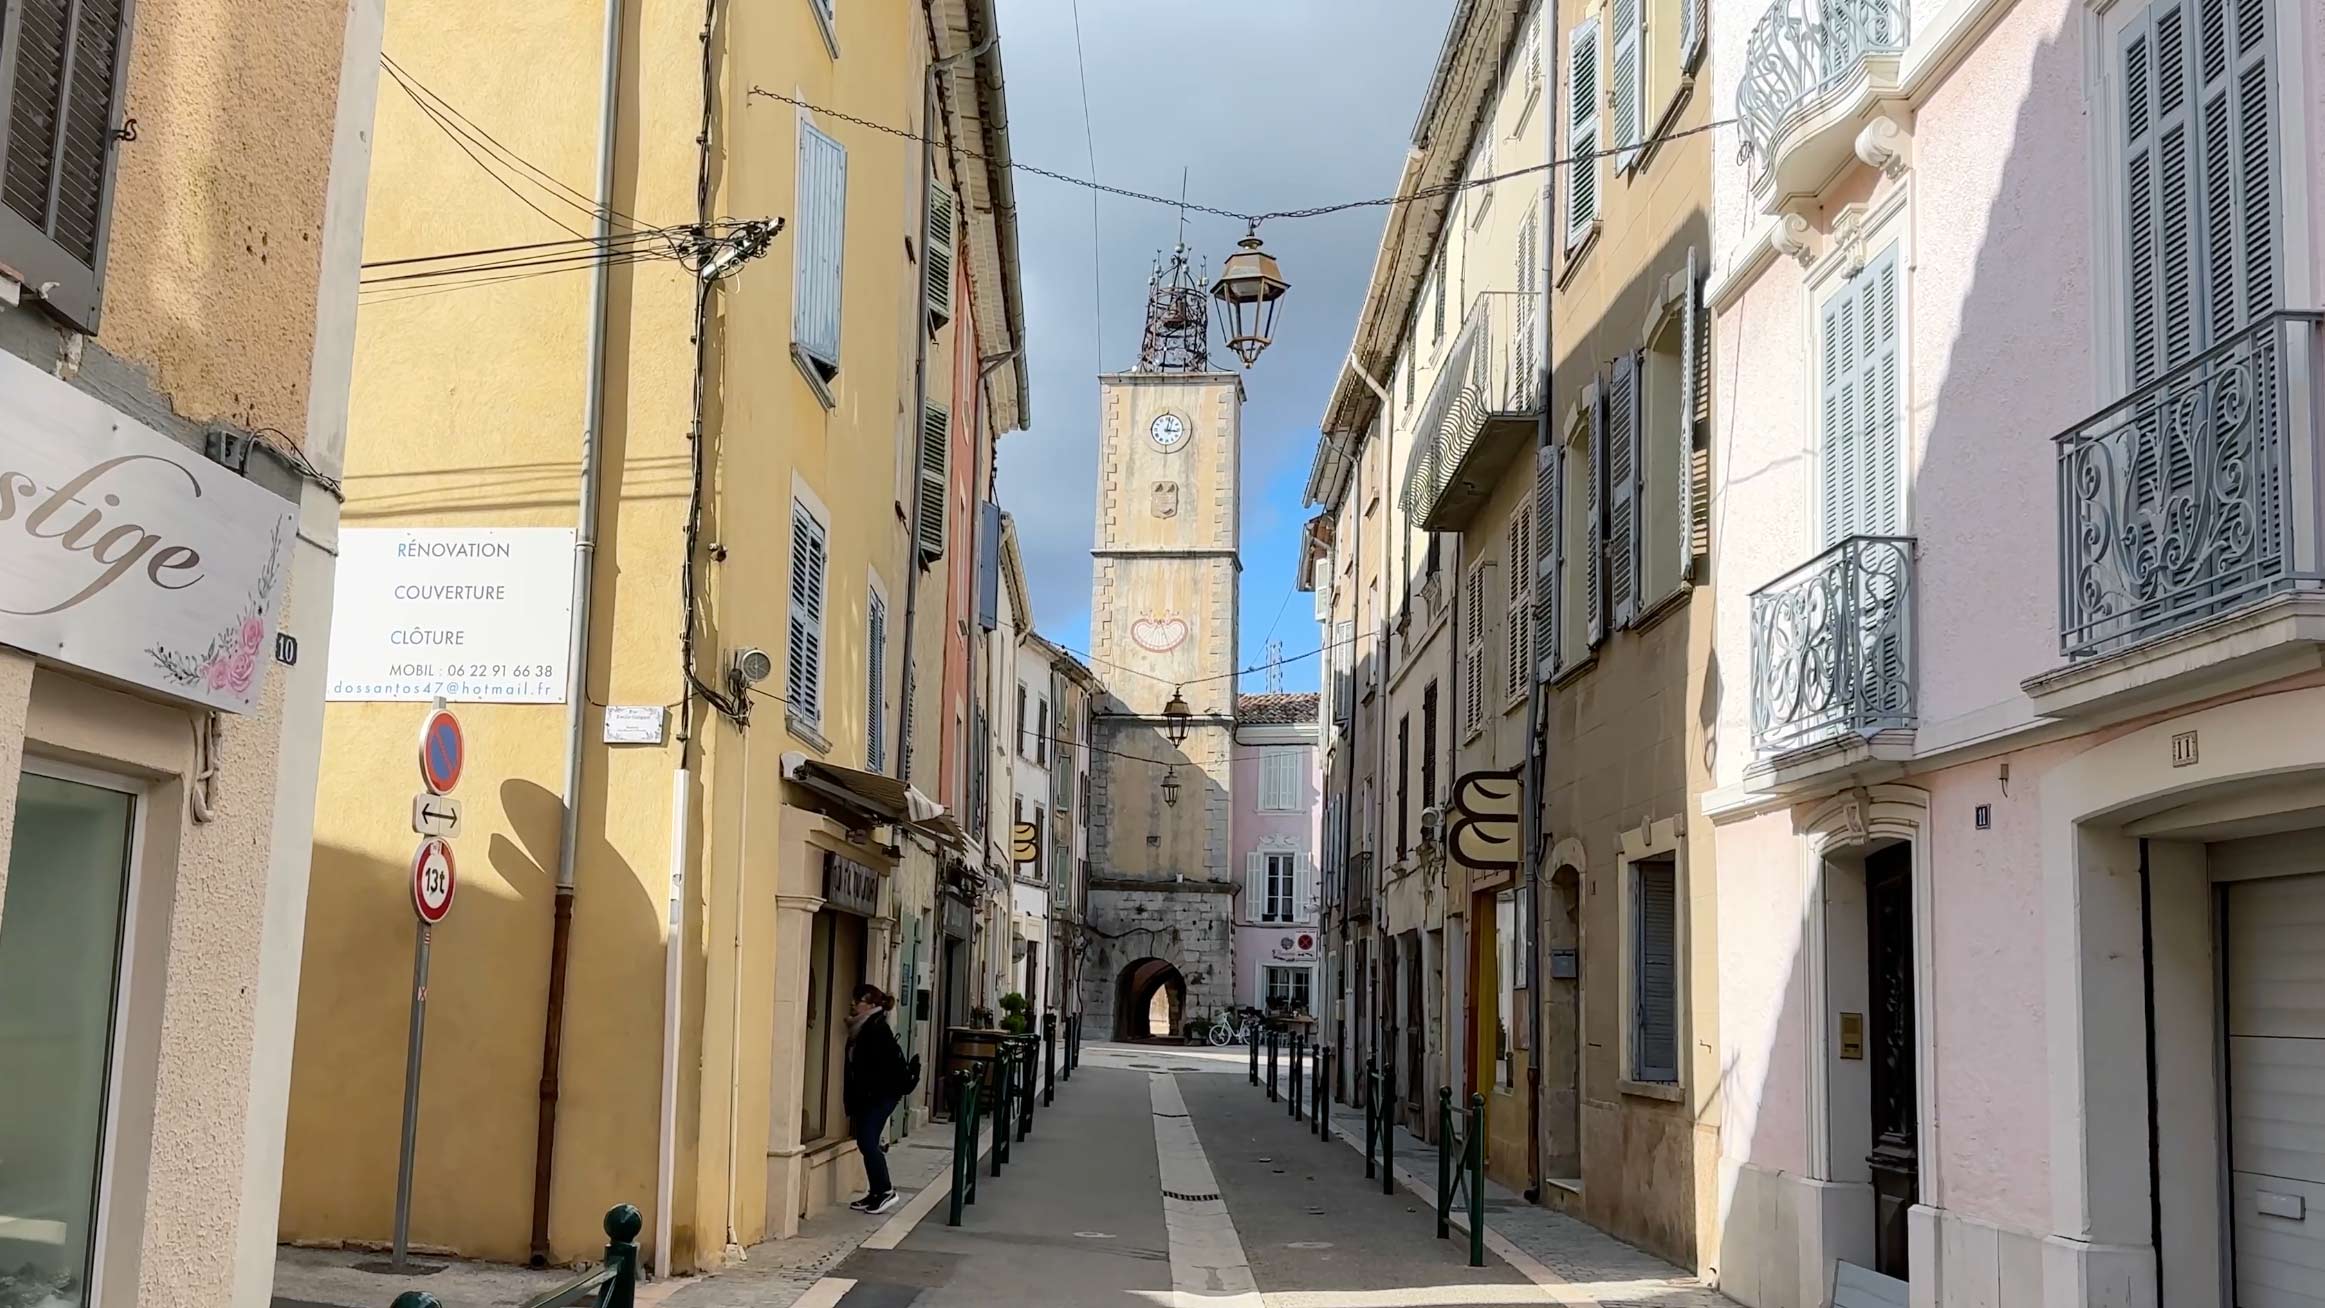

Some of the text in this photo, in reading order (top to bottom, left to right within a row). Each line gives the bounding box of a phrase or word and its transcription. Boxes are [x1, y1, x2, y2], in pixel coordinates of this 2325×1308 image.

[397, 539, 510, 558] RÉNOVATION
[394, 585, 505, 600] COUVERTURE
[390, 627, 464, 645] CLÔTURE
[278, 636, 294, 663] 10
[389, 664, 434, 677] MOBIL
[447, 664, 465, 677] 06
[469, 664, 487, 677] 22
[492, 664, 507, 677] 91
[513, 664, 530, 677] 66
[535, 664, 553, 678] 38
[2177, 738, 2190, 760] 11
[425, 867, 445, 895] 13t
